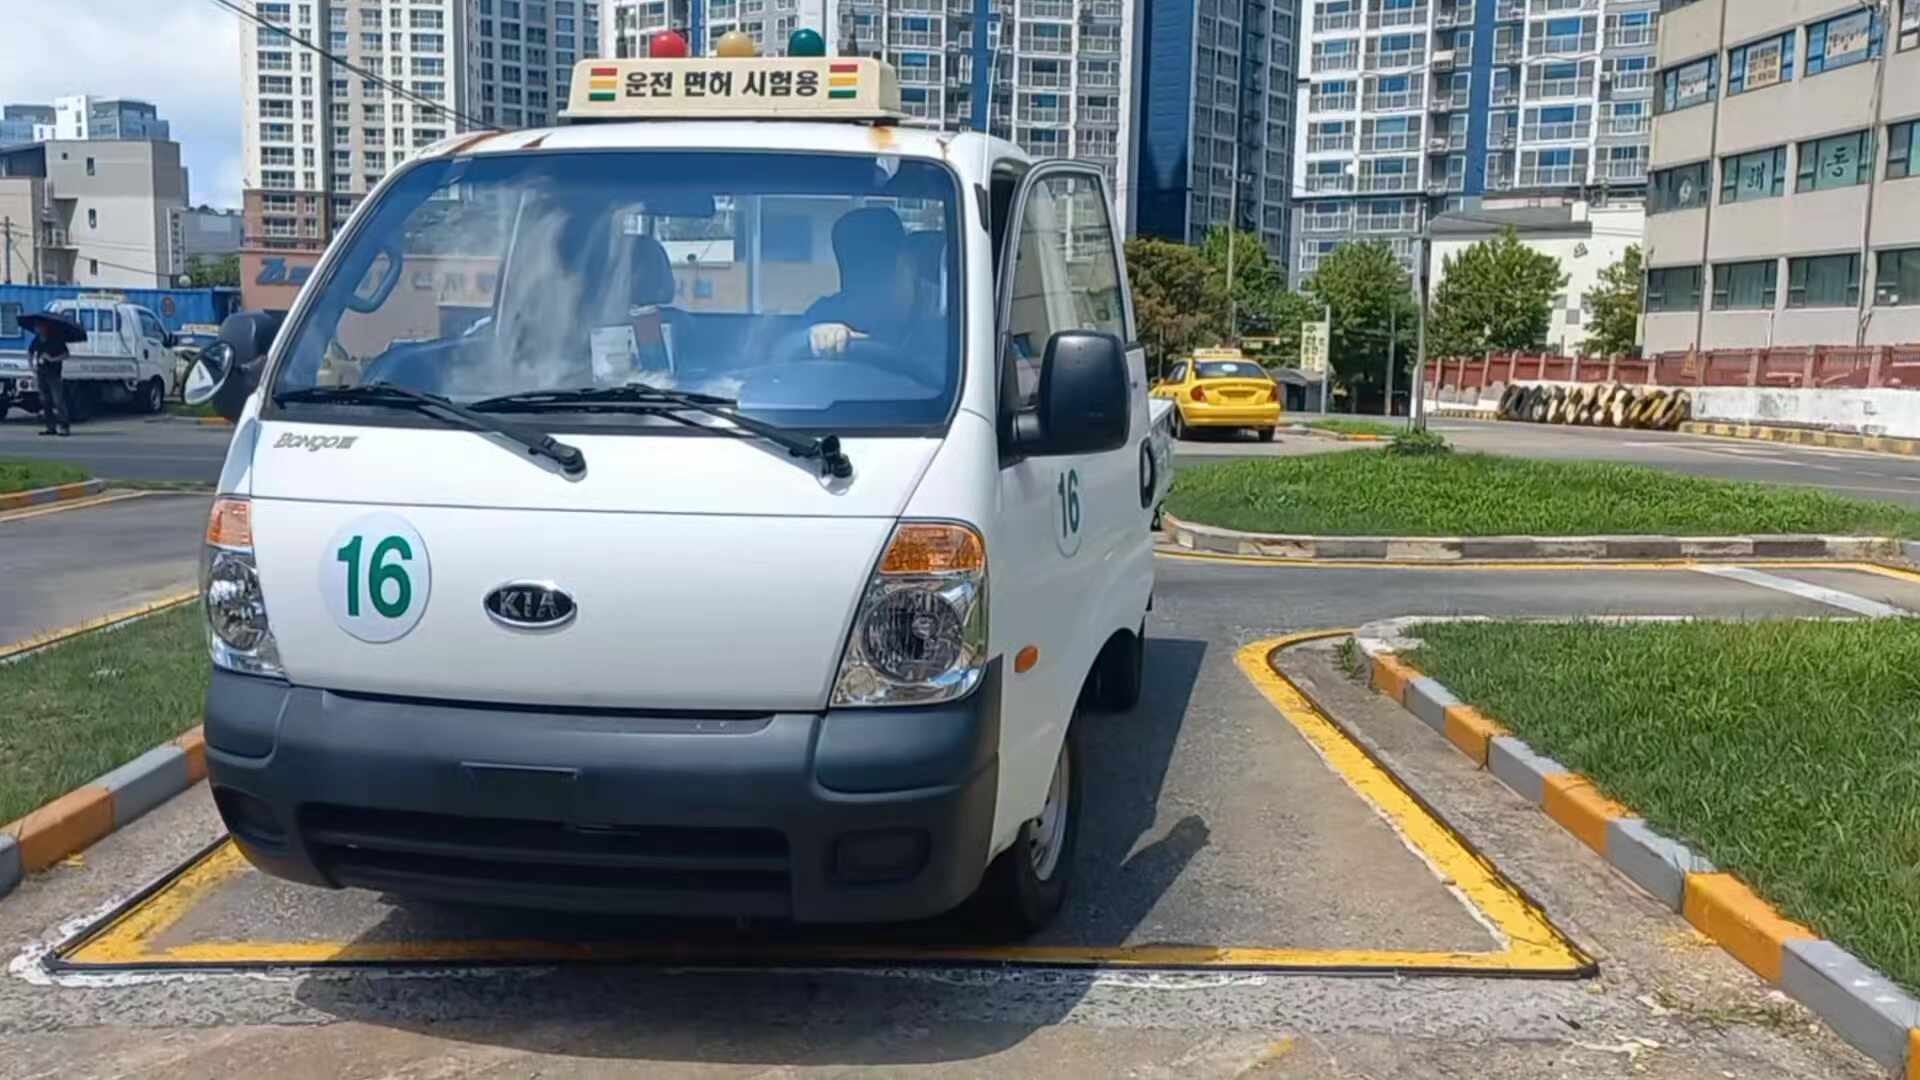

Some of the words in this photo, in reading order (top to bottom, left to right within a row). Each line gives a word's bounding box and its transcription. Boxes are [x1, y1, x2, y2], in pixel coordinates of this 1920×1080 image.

[625, 71, 673, 97] 운전
[684, 70, 733, 97] 면허
[742, 69, 819, 97] 시험용
[1057, 468, 1080, 539] 16
[337, 535, 413, 619] 16
[500, 591, 560, 618] KIA
